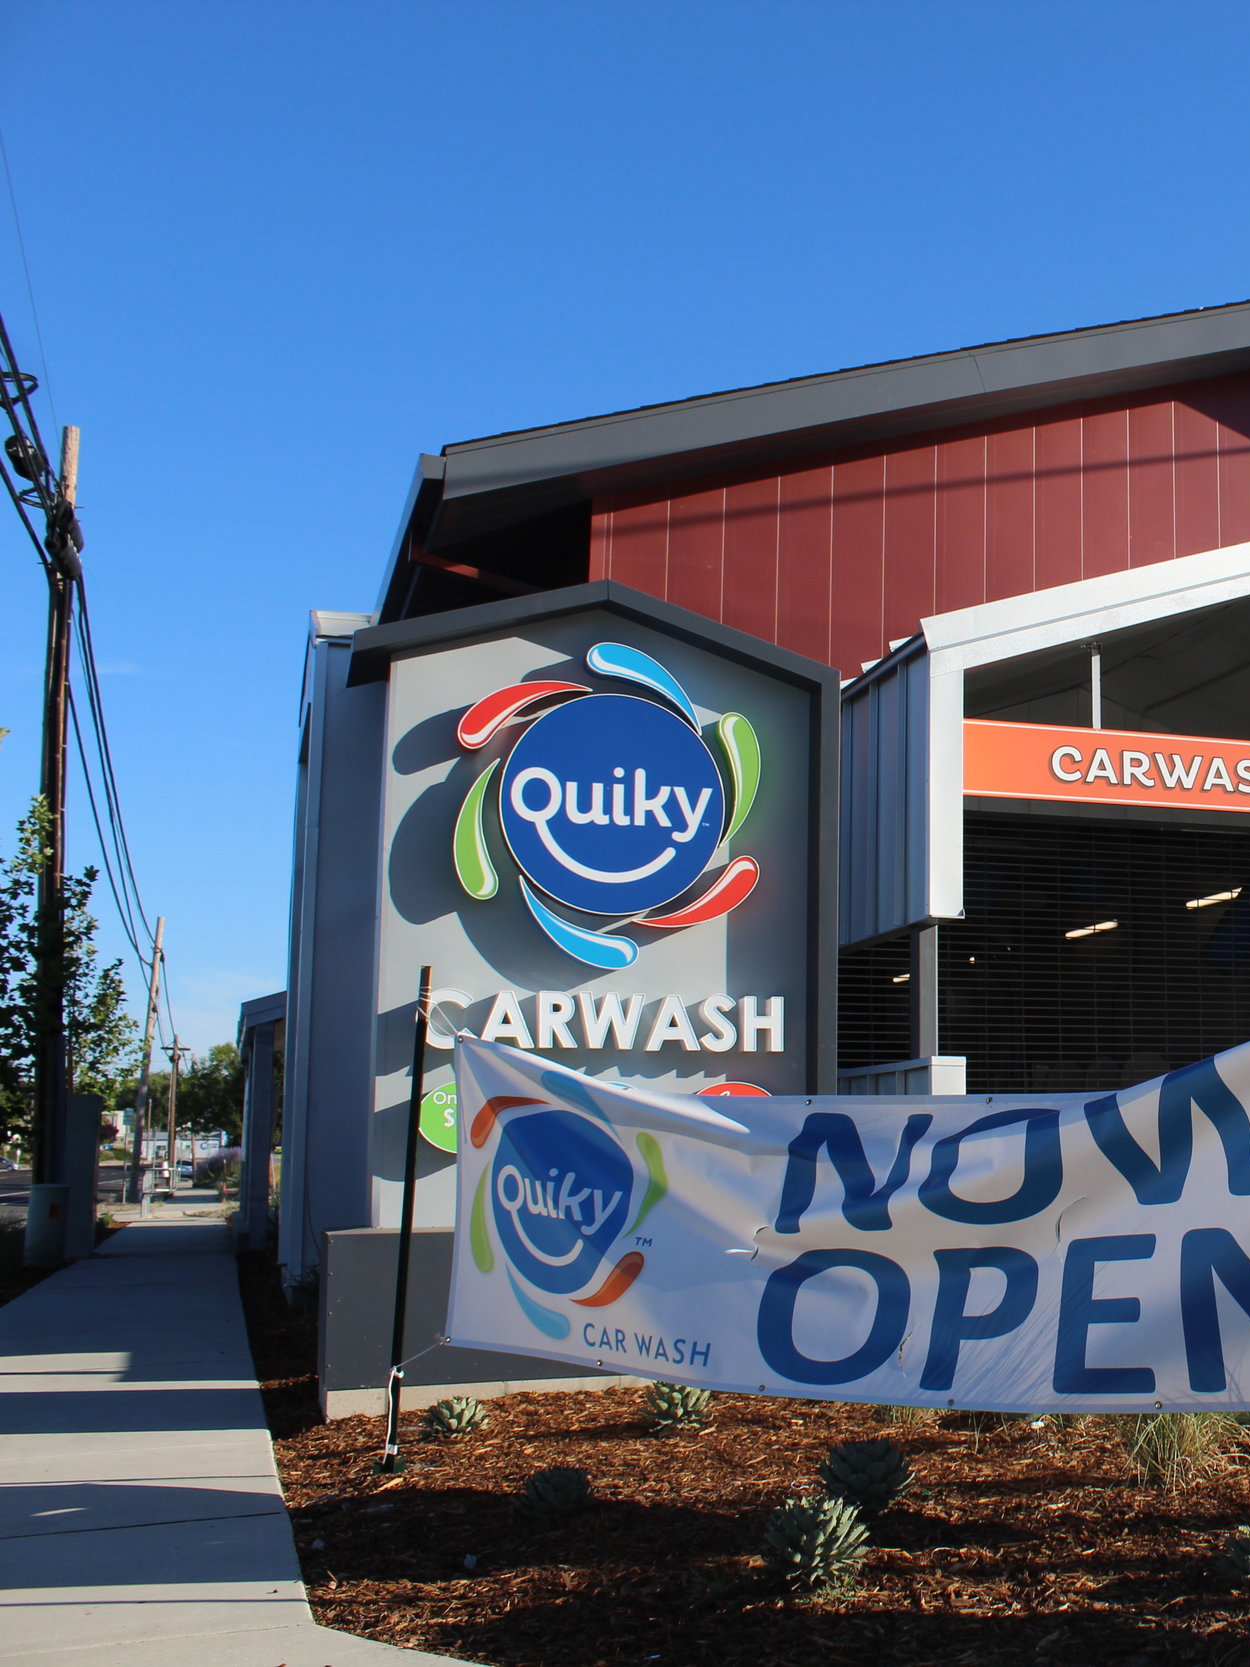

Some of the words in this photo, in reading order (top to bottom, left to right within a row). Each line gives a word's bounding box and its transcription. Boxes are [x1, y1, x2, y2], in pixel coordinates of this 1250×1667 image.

[510, 766, 713, 843] Quiky
[415, 987, 785, 1053] CARWASH
[497, 1164, 623, 1236] Quiky
[583, 1322, 628, 1354] CAR
[634, 1331, 712, 1368] WASH
